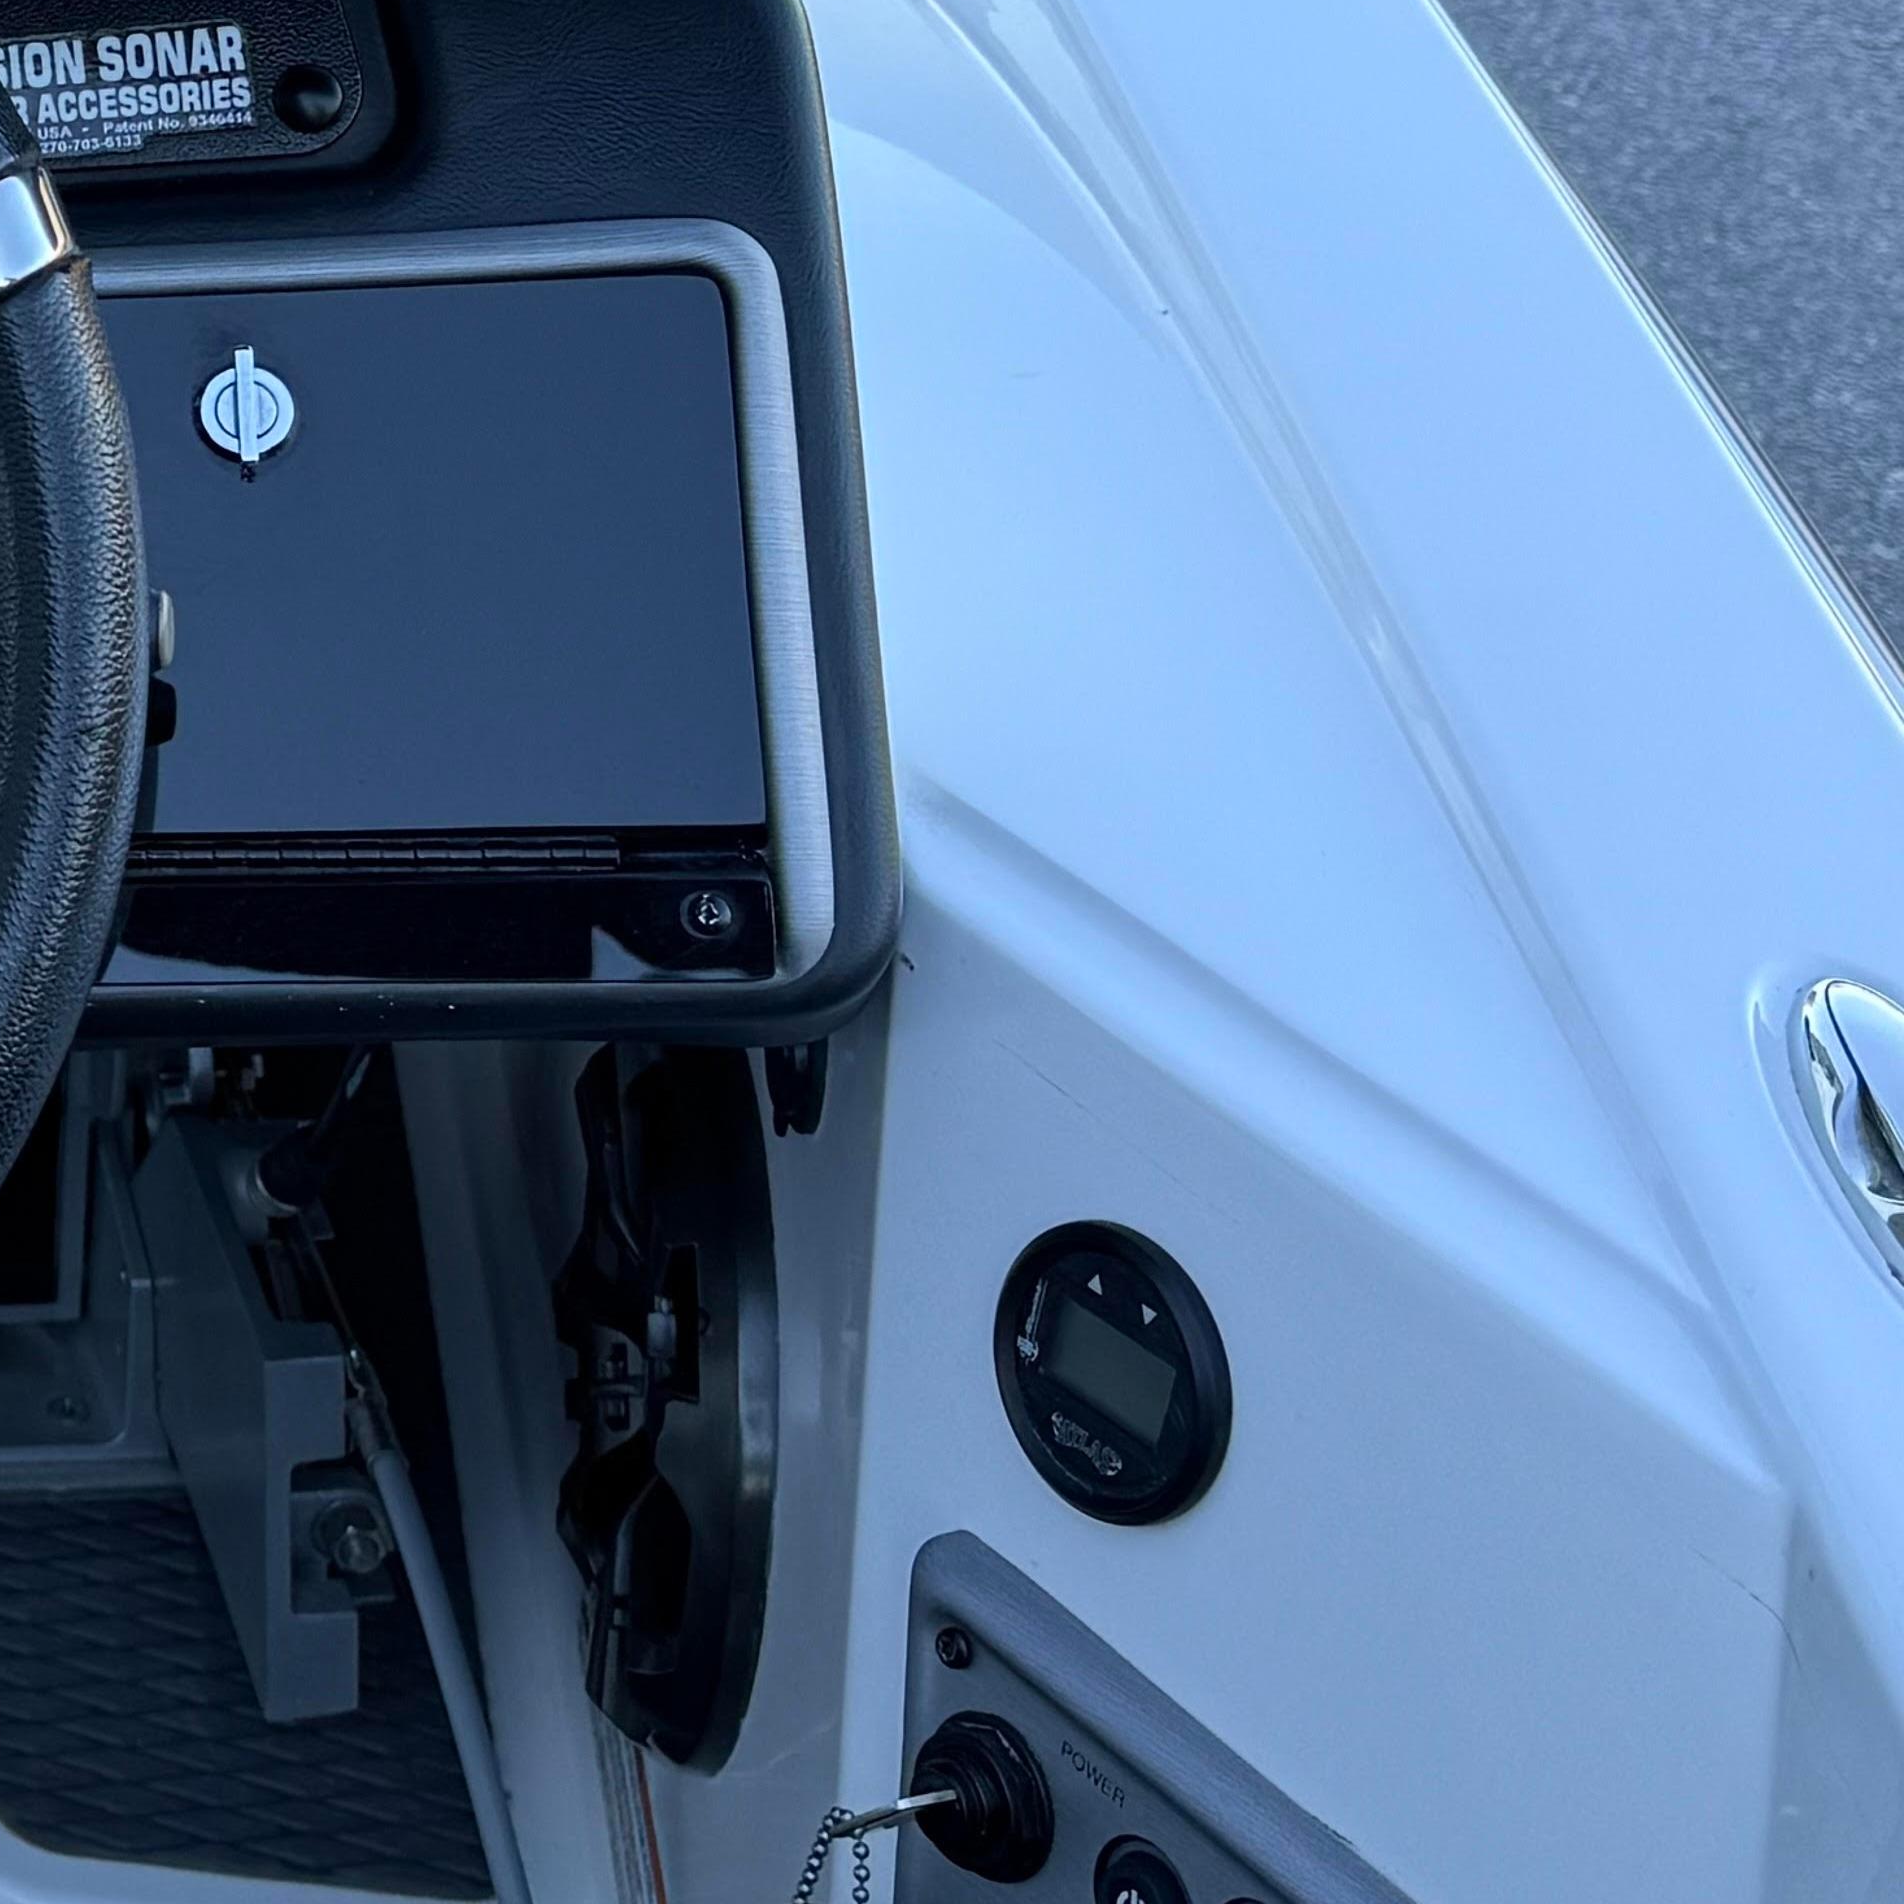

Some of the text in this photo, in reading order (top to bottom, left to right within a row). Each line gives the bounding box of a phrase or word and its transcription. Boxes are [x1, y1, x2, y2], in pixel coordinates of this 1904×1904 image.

[96, 25, 246, 82] SONAR
[37, 77, 252, 124] ACCESSORIES
[37, 125, 73, 141] USA
[1060, 1739, 1127, 1809] POWER
